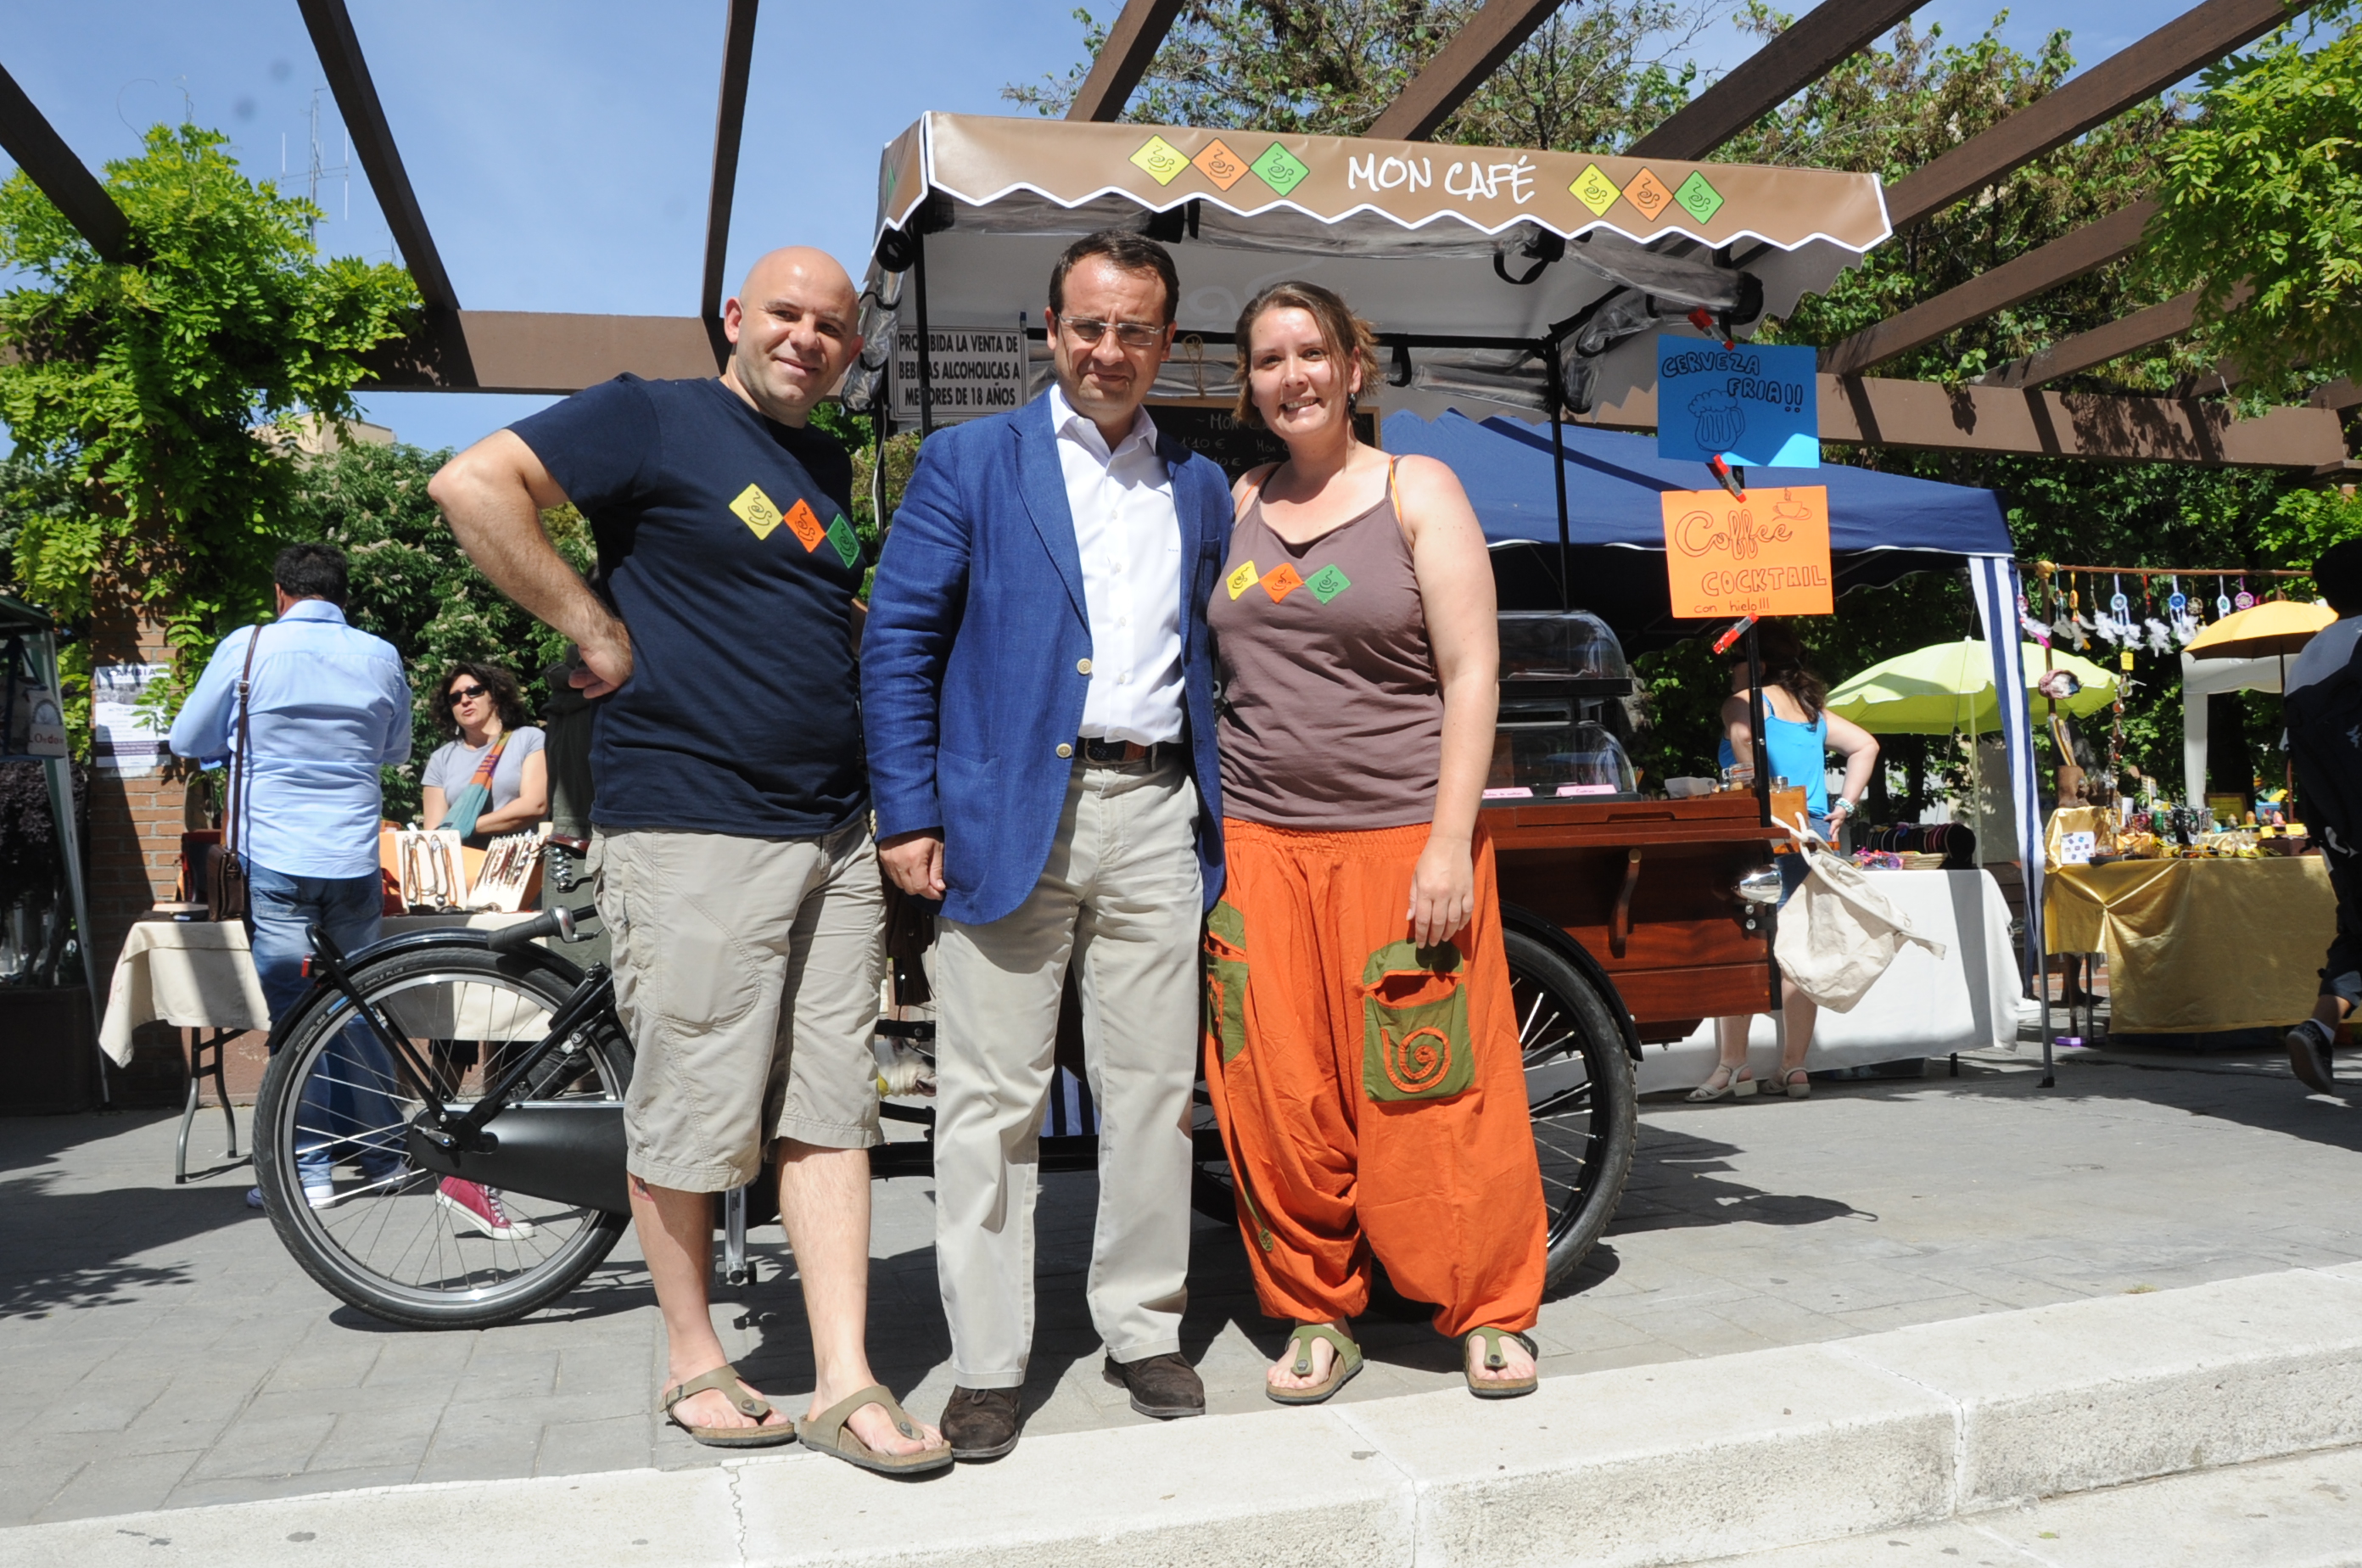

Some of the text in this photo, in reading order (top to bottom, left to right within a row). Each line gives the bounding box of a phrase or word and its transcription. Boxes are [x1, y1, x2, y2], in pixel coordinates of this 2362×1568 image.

[1347, 152, 1536, 204] MON CAFÉ
[956, 334, 969, 353] LA
[971, 335, 1004, 353] VENTA
[1006, 335, 1018, 353] DE
[898, 361, 1021, 380] BEBIAS ALCOHOLICAS A
[1661, 351, 1760, 378] CERVEZA
[904, 382, 1016, 406] MEORES DE 18 AÑOS
[1727, 378, 1804, 413] FRIA!!
[1674, 508, 1793, 561] Coffee
[1701, 565, 1827, 597] COCKTAIL
[1693, 604, 1718, 613] con
[106, 668, 156, 677] CAMBIA
